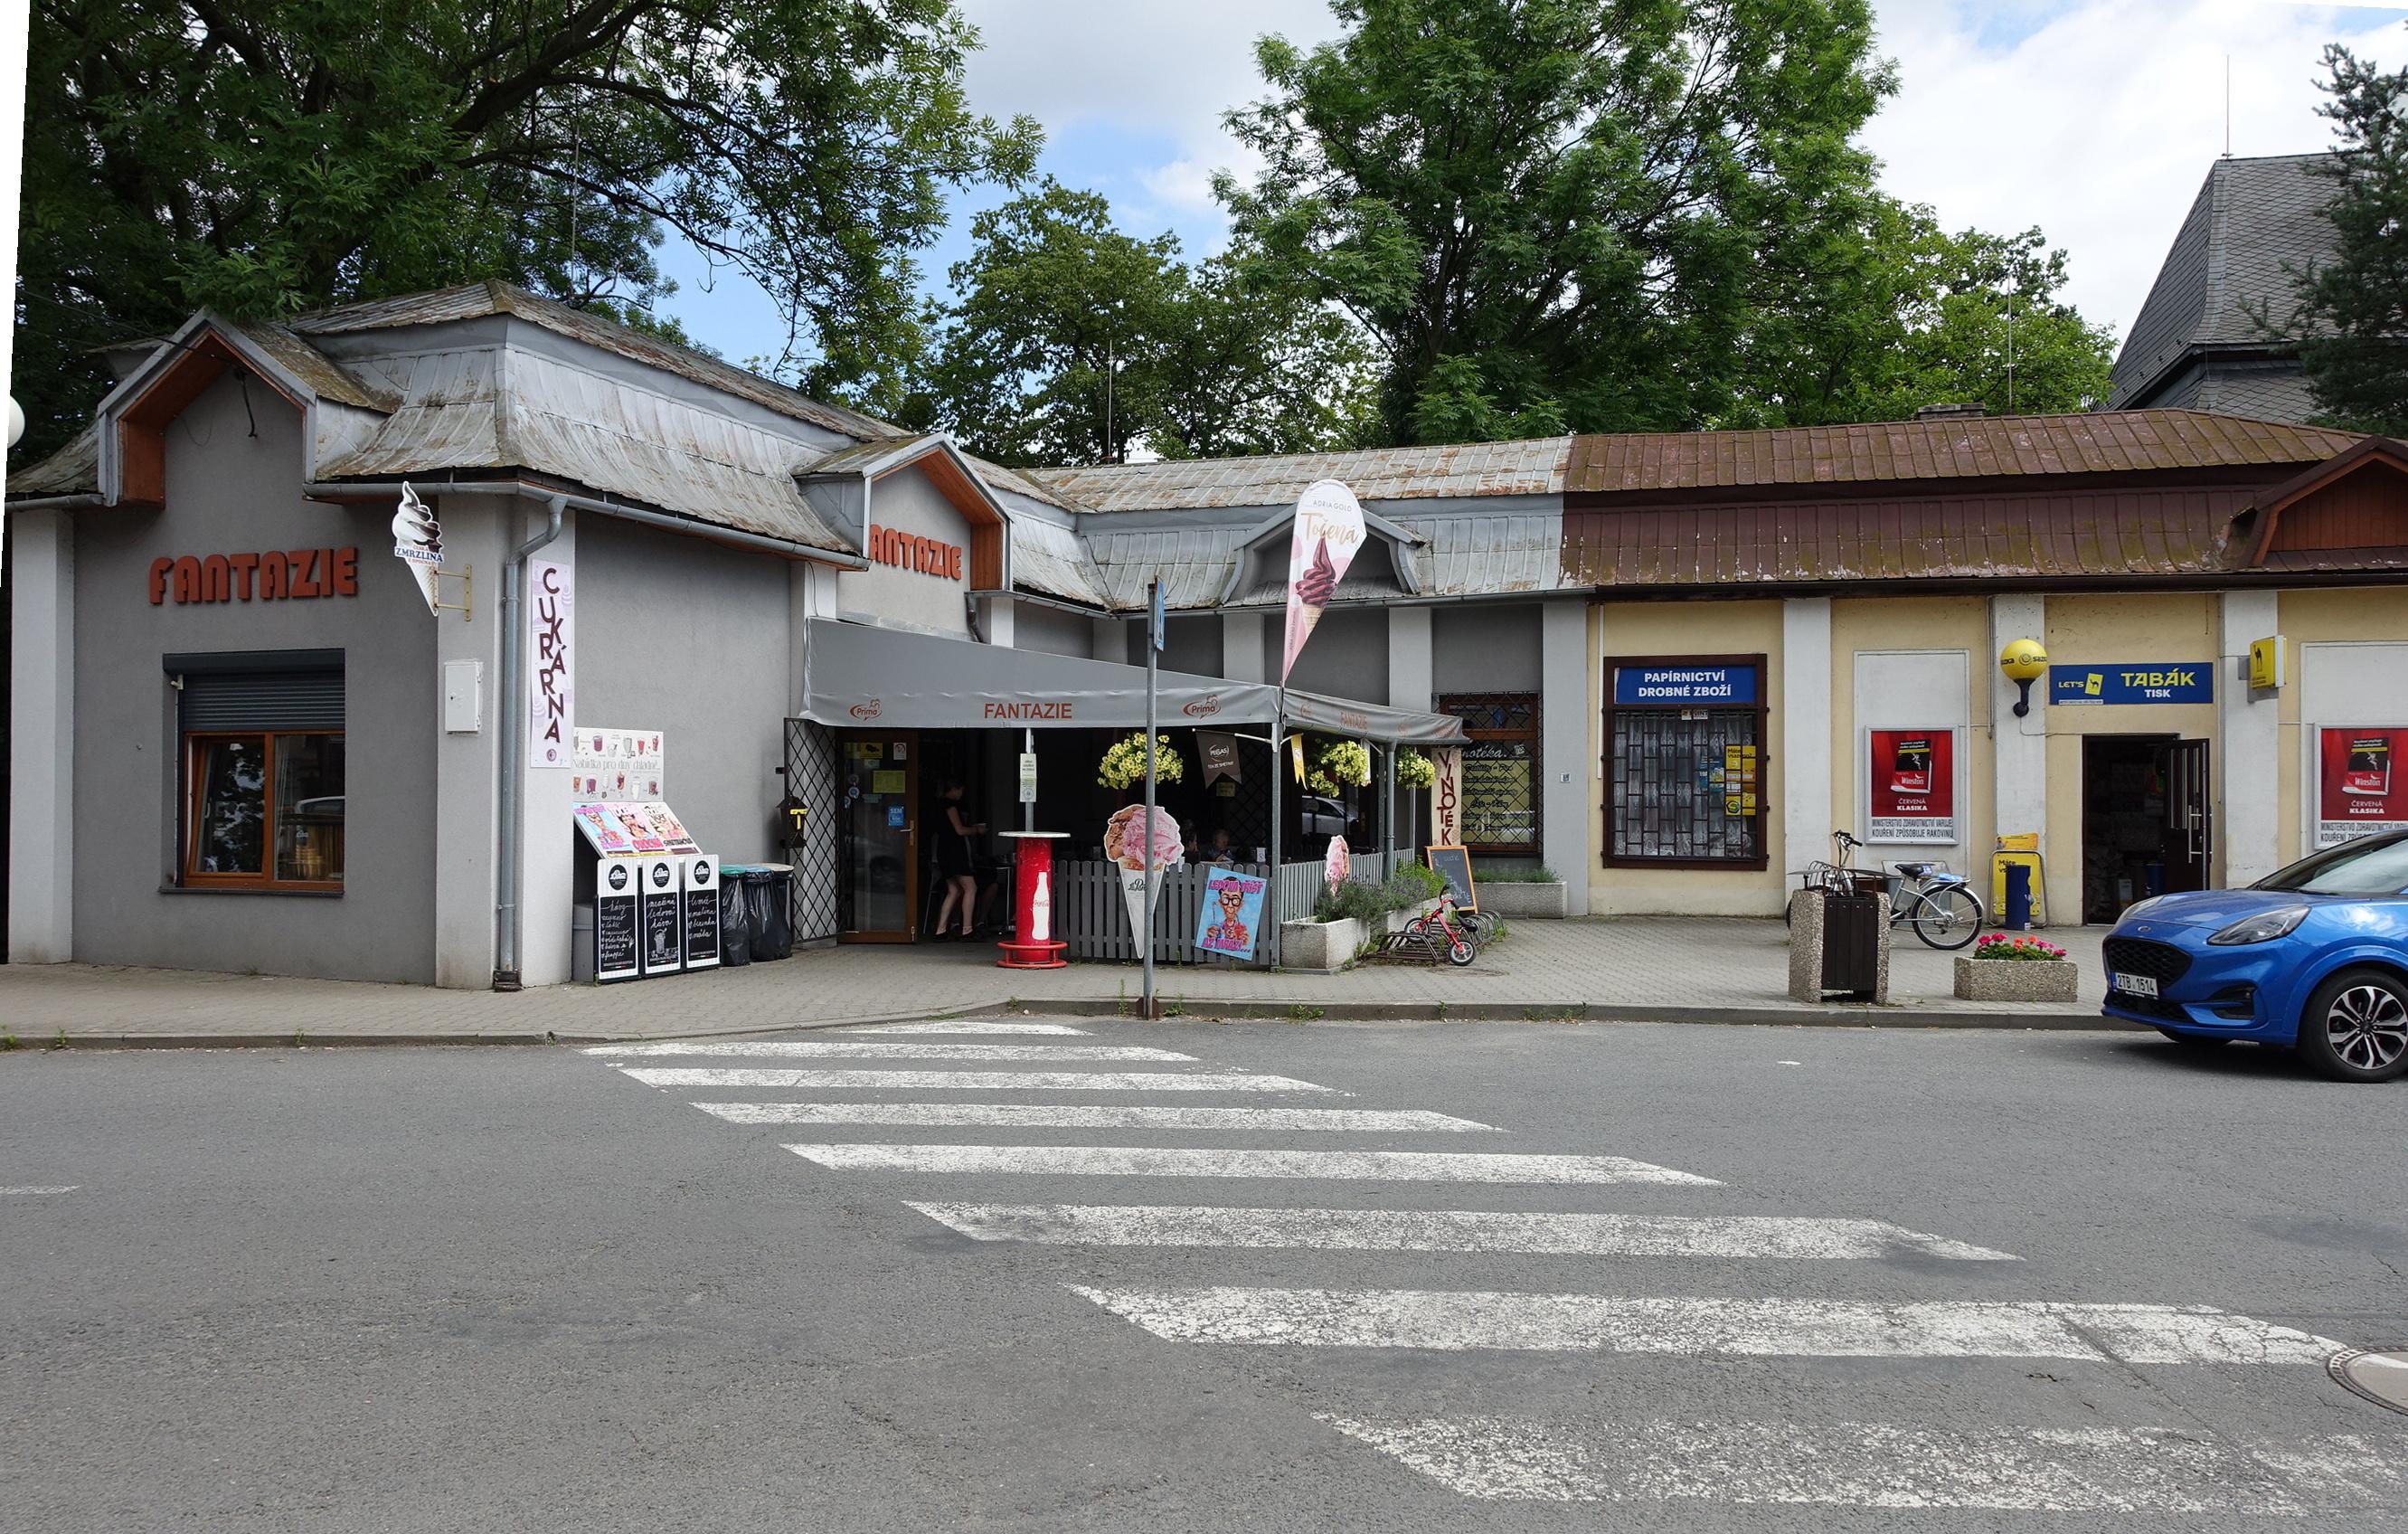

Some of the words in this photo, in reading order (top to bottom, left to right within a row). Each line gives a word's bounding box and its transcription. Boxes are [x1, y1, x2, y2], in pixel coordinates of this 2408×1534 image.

[1301, 513, 1359, 544] Točená
[395, 547, 443, 562] ZMRZLINA
[869, 524, 961, 581] ANTAZIE
[149, 547, 358, 604] FANTAZIE
[538, 567, 567, 743] CUKRÁRNA
[1644, 669, 1725, 683] PAPÍRNICTVÍ
[2120, 668, 2196, 687] TABÁK
[1638, 685, 1690, 697] DROBNÉ
[1693, 684, 1732, 696] ZBOŽÍ
[2144, 689, 2171, 698] TISK
[984, 702, 1072, 719] FANTAZIE
[1902, 776, 1924, 785] Winston
[2355, 777, 2381, 786] Winston
[1436, 750, 1456, 846] VINOTÉK
[1872, 819, 1902, 827] MINISTERSTVO
[1903, 818, 1935, 827] ZDRAVOTNICTVÍ
[2321, 822, 2355, 830] MINISTERSTVO
[1872, 828, 1894, 837] KOUŘENÍ
[1895, 828, 1925, 838] ZPŮSOBUJE
[1926, 829, 1953, 838] RAKOVINU
[2320, 832, 2346, 842] KOUŘENÍ
[2117, 974, 2131, 989] 2TB
[2136, 978, 2155, 993] 1514
